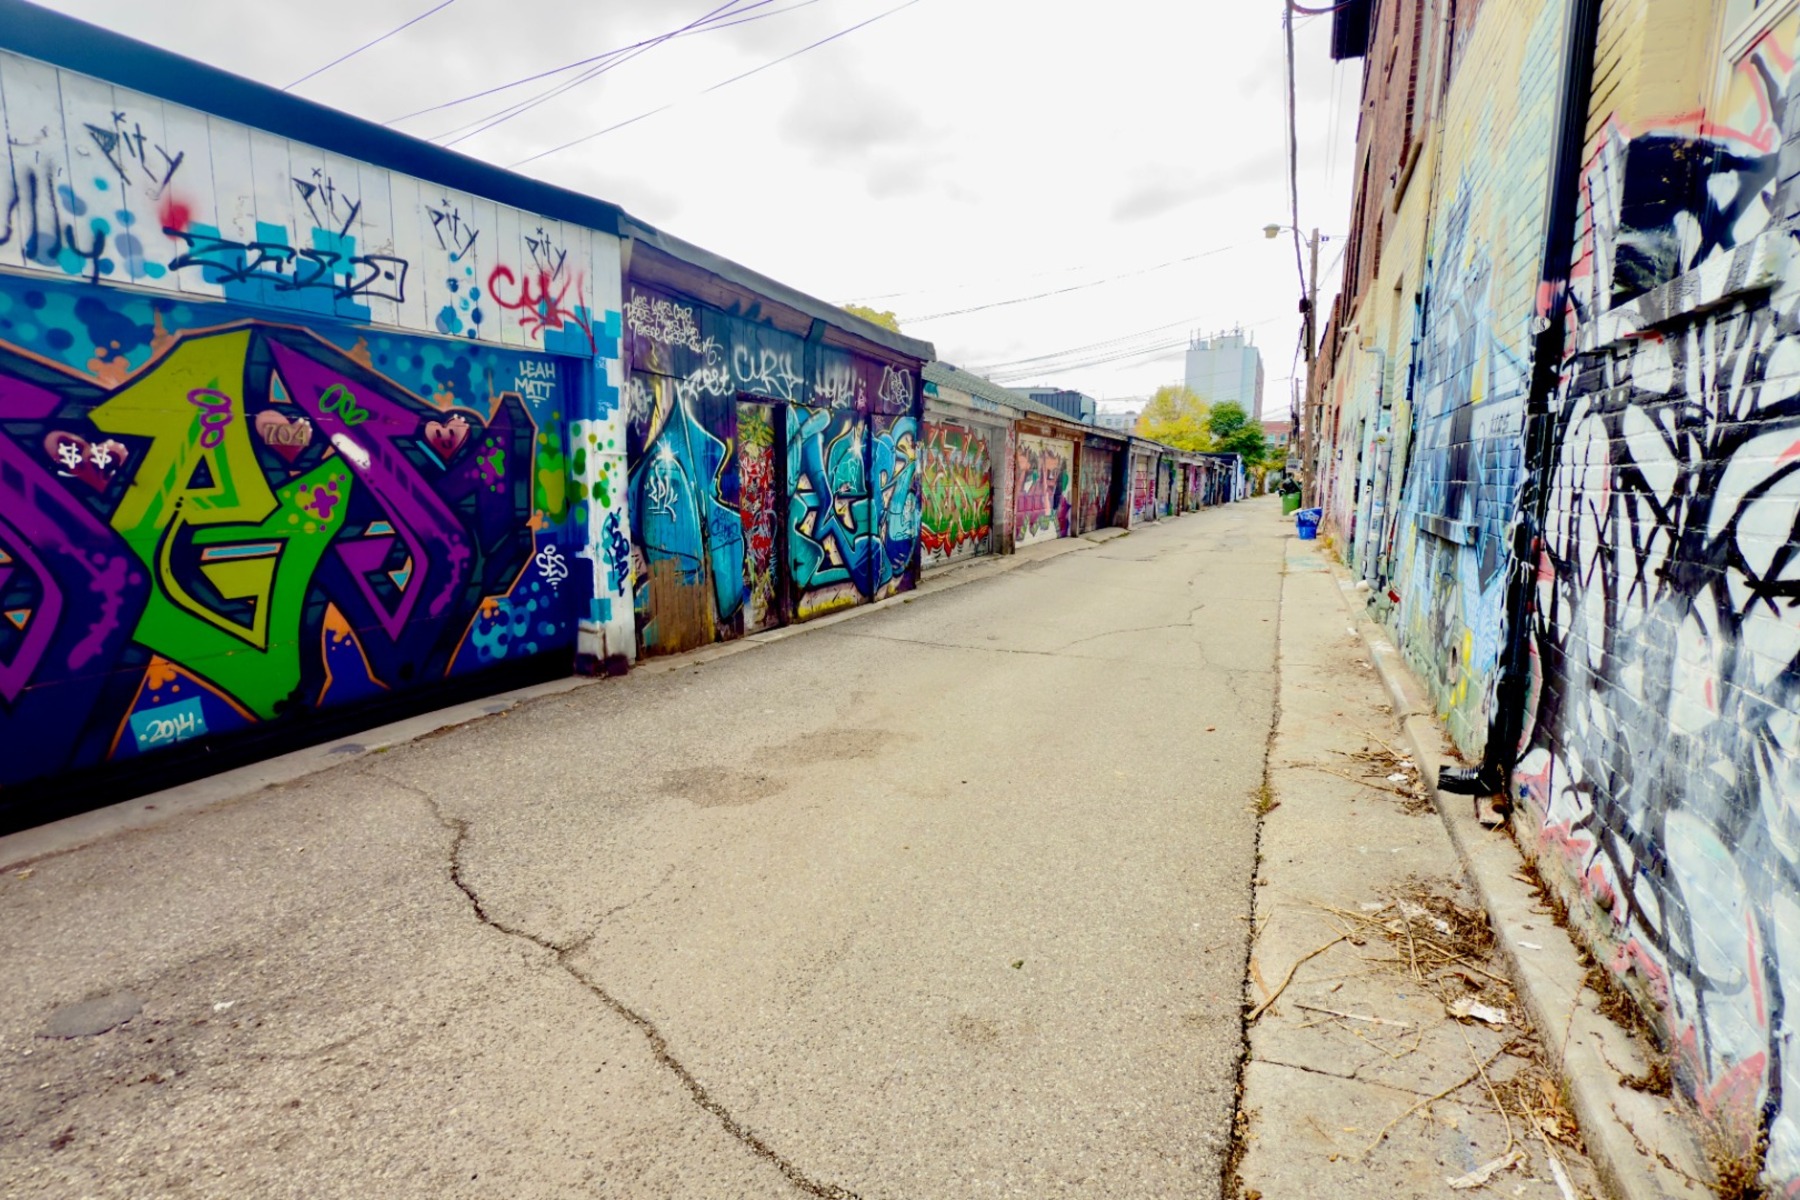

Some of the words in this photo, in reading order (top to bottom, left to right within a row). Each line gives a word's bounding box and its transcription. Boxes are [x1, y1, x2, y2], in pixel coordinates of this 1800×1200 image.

[518, 360, 556, 379] LEAH
[514, 377, 557, 400] MATT
[262, 422, 310, 447] 704
[145, 711, 196, 743] 2014
